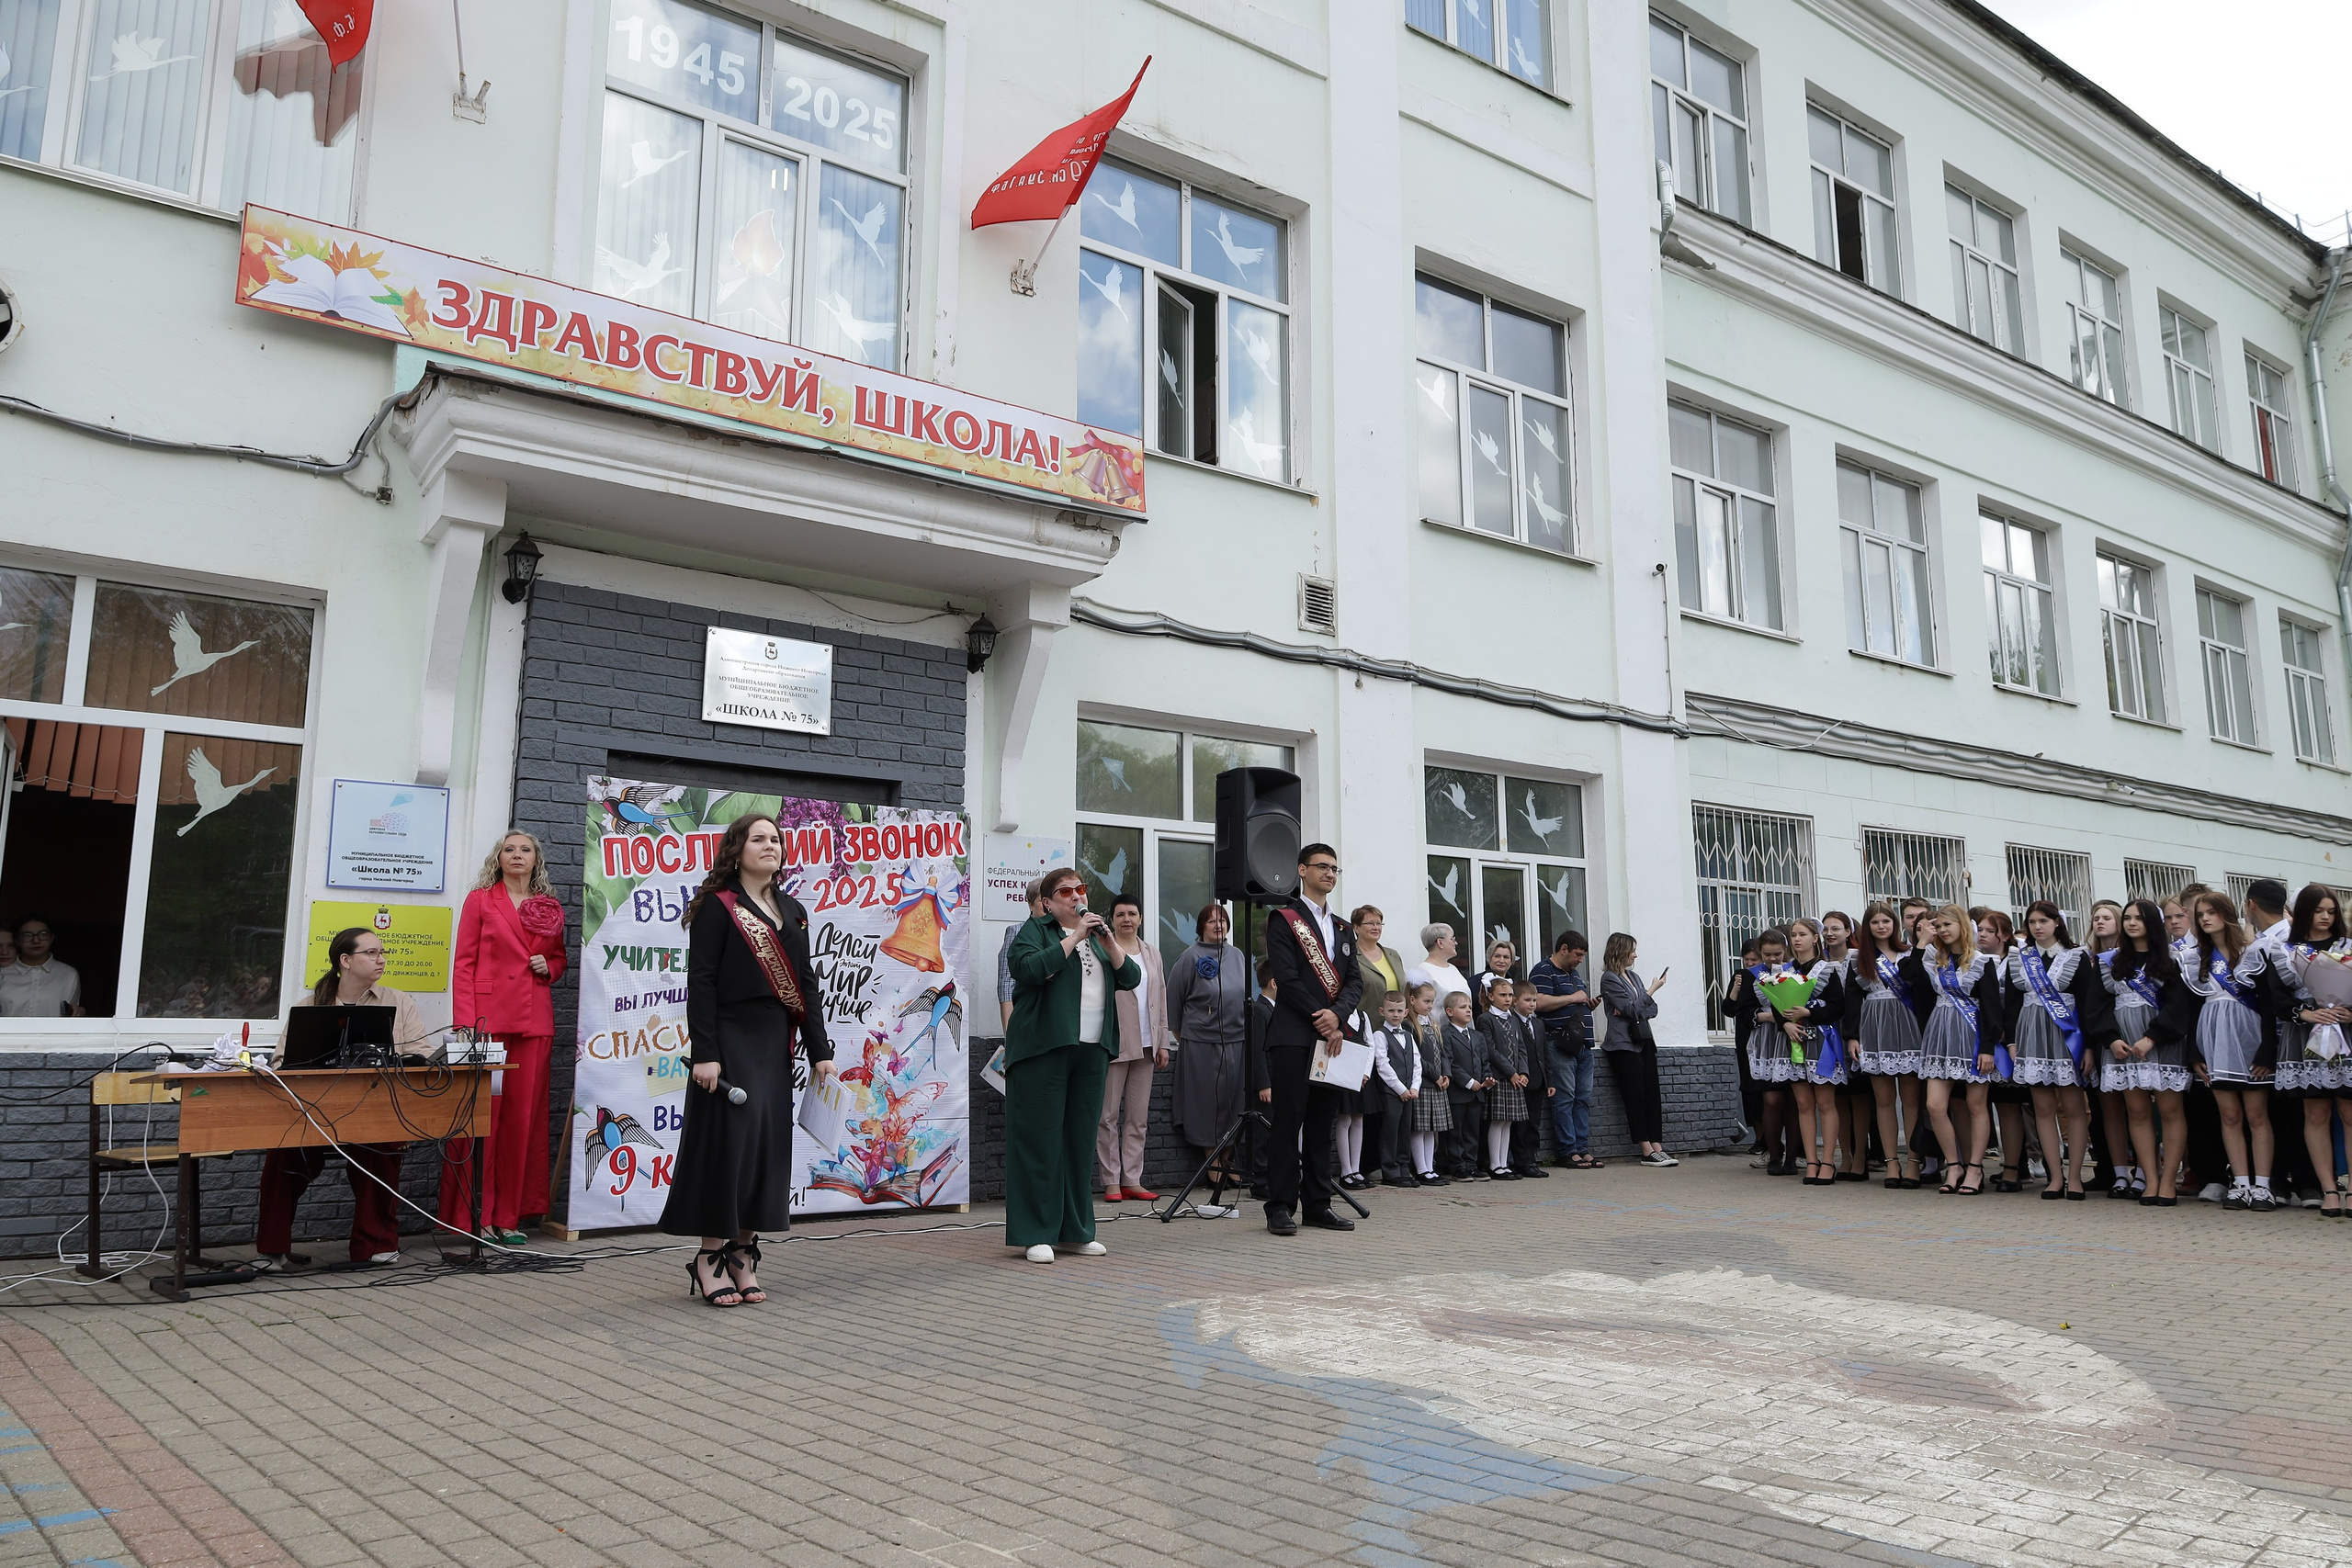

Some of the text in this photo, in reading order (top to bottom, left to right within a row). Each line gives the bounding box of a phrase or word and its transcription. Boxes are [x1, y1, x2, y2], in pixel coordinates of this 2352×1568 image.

[615, 16, 897, 150] 1945 2025
[431, 278, 1061, 475] ЗДРАВСТВУЙ, ШКОЛА!
[718, 675, 820, 694] МУНИЦИПАЛЬНОЕ БЮДЖЕТНОЕ
[729, 683, 808, 699] ОБЩЕОБРАЗОВАТЕЛЬНОЕ
[747, 693, 791, 704] УЧРЕЖДЕНИЕ
[716, 703, 819, 725] «ШКОЛА № 75»
[843, 822, 965, 863] ЗВОНОК
[342, 855, 401, 863] ОБЩЕОБРАЗОВАТЕЛЬНОЕ
[352, 865, 390, 874] «Школа
[987, 867, 1041, 877] ФЕДЕРАЛЬНЫЙ
[813, 873, 905, 913] 2025
[988, 879, 1018, 889] УСПЕХ
[614, 987, 688, 1012] ВЫ ЛУЧШ
[2049, 999, 2070, 1018] 2025
[658, 1056, 688, 1079] ВА
[609, 1145, 637, 1196] 9
